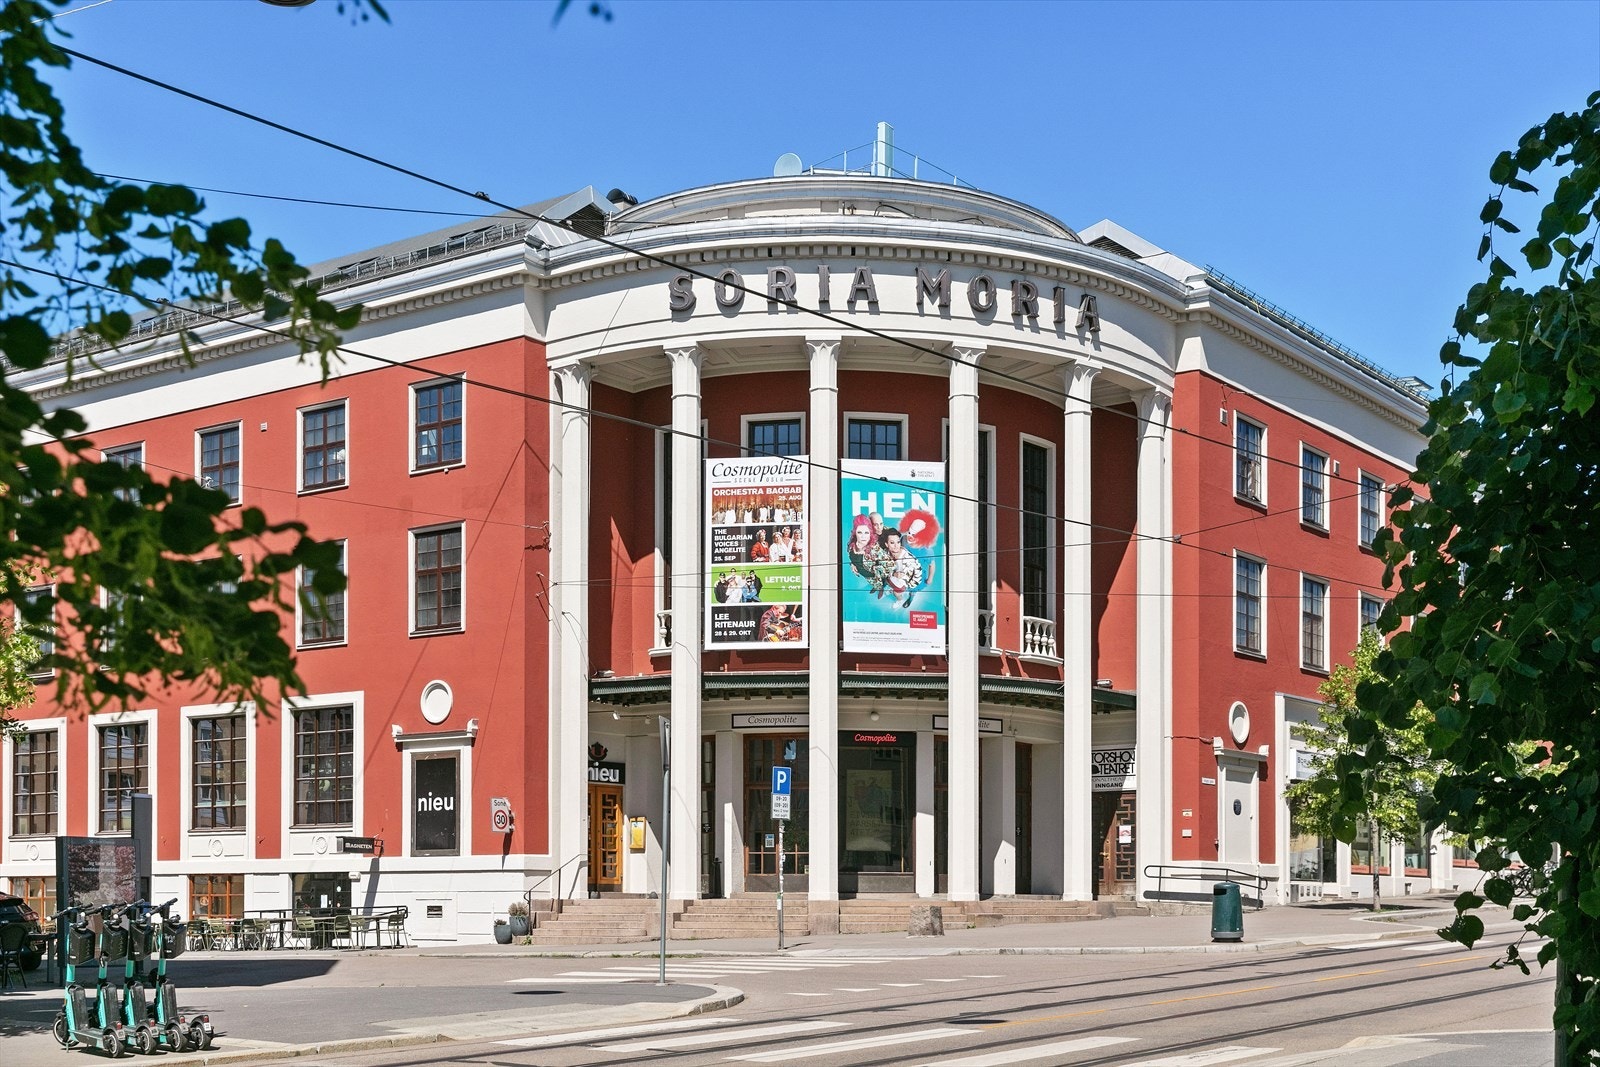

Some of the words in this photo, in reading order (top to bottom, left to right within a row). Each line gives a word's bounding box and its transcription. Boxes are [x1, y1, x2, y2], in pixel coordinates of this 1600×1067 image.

[668, 264, 880, 312] SORIA
[914, 266, 1101, 332] MORIA
[712, 459, 803, 482] Cosmopolite
[713, 488, 764, 497] ORCHESTRA
[766, 486, 802, 495] BAOBAB
[851, 490, 936, 519] HEN
[765, 575, 801, 583] LETTUCE
[747, 715, 797, 726] Cosmopolite
[854, 733, 897, 744] Cosmopolite
[588, 761, 620, 782] nieu
[1099, 762, 1135, 775] TEATRET
[777, 770, 787, 791] P
[417, 791, 454, 812] nieu
[493, 799, 507, 807] Sone
[496, 814, 506, 825] 30
